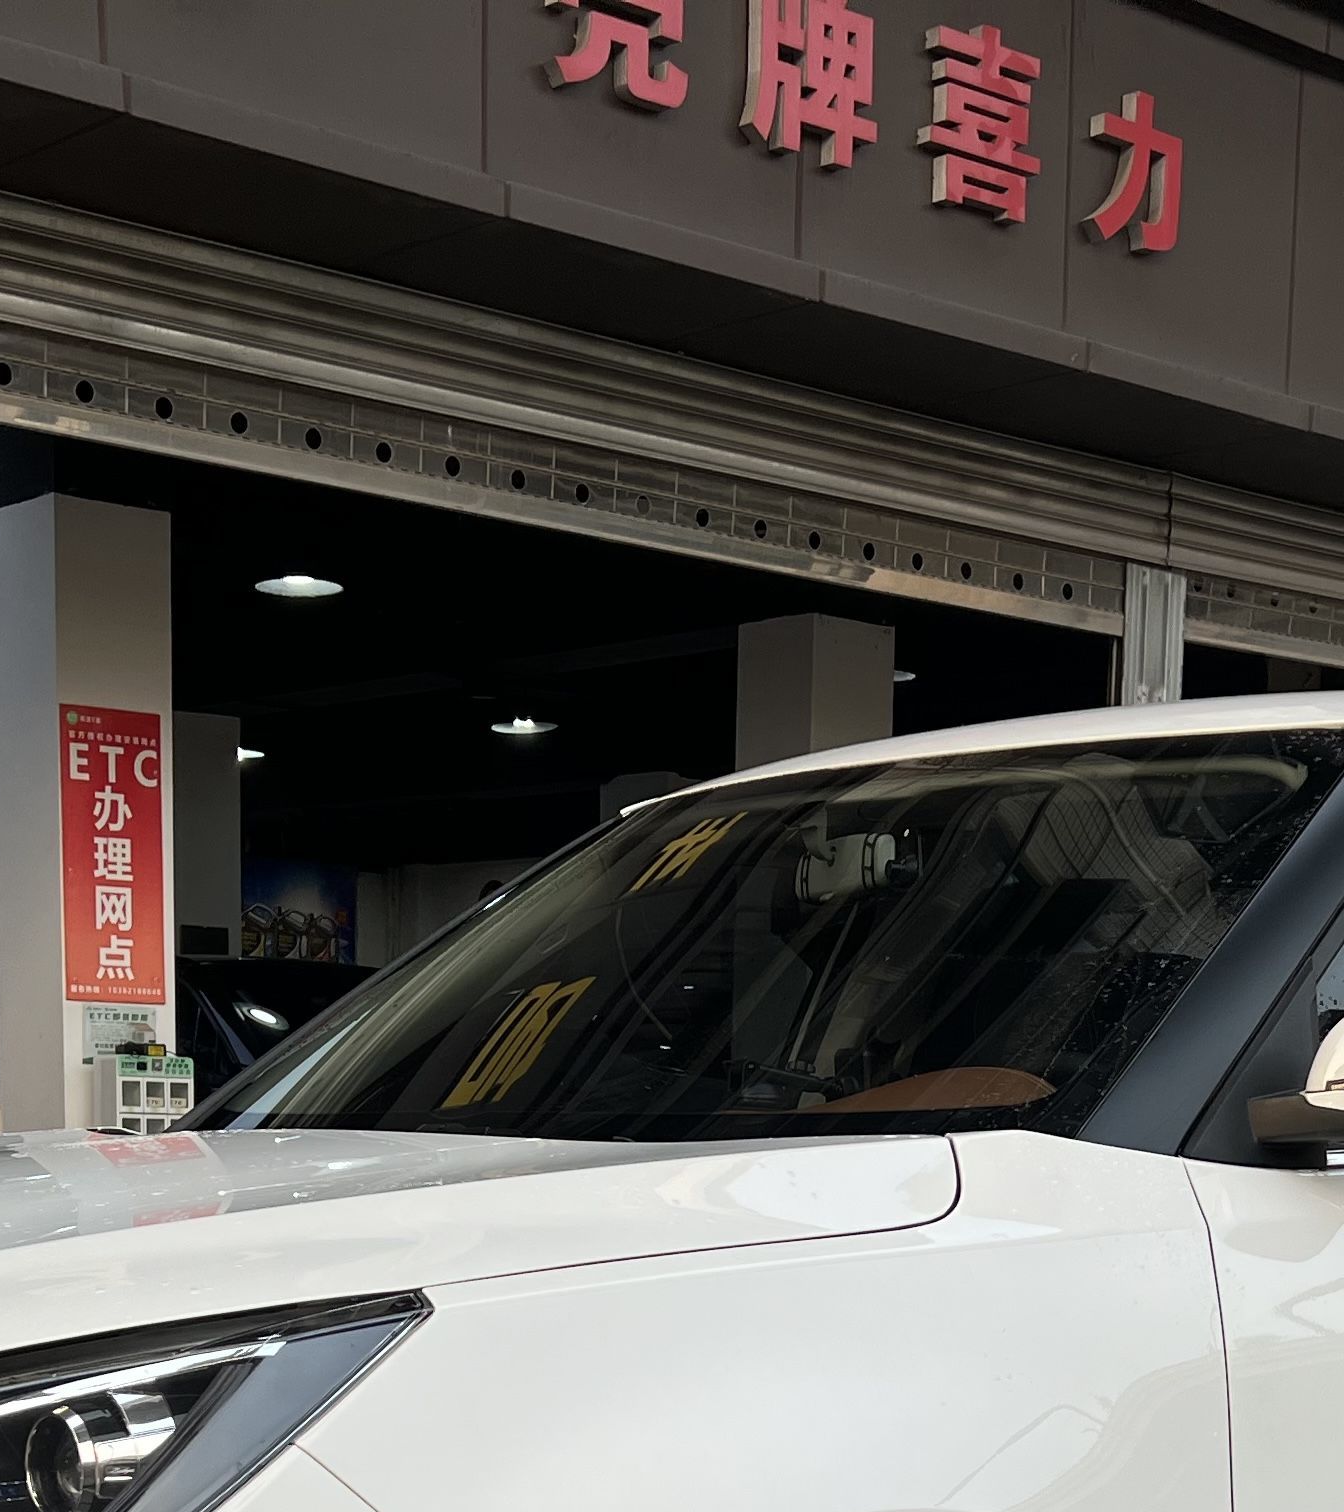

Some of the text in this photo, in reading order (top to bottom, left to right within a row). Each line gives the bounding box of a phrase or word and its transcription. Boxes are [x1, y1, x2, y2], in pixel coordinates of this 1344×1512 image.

[68, 743, 159, 788] ETC
[92, 785, 135, 982] 办理网点
